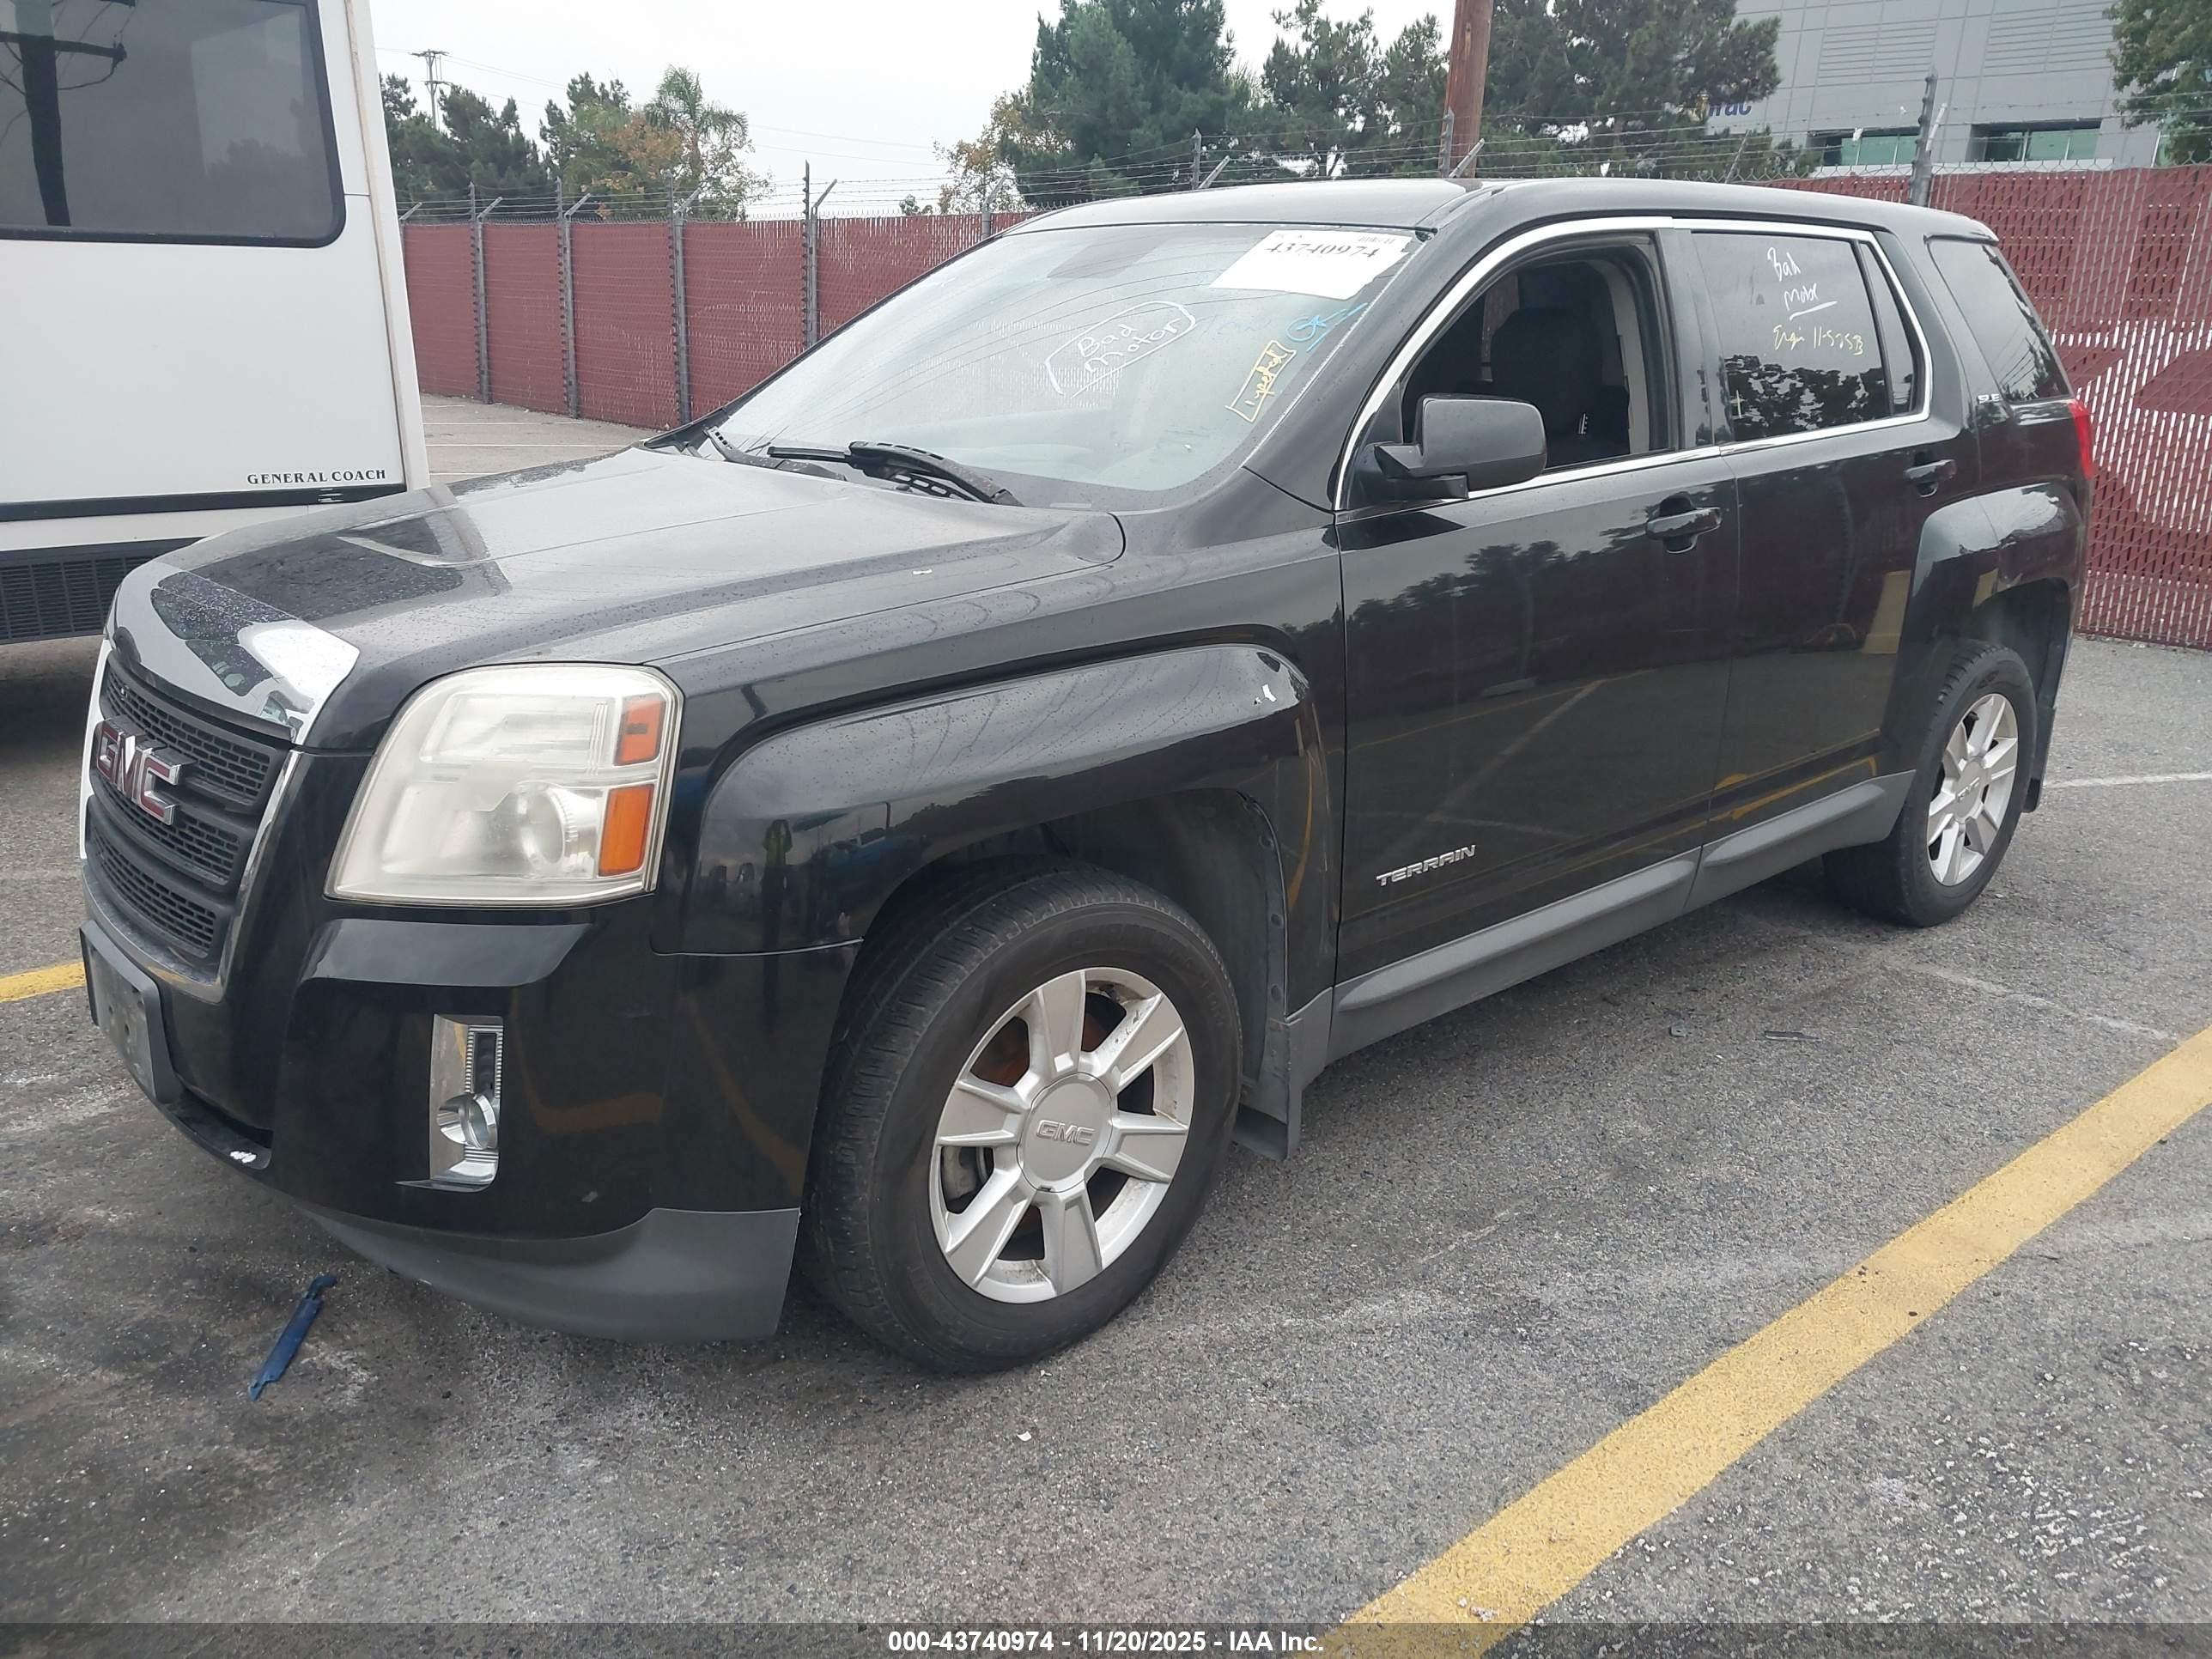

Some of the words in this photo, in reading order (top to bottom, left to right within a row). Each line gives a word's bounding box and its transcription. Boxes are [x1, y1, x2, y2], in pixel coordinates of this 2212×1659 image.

[1264, 241, 1381, 258] 43740974
[1077, 322, 1138, 358] Bad
[246, 472, 328, 484] GENERAL
[331, 470, 386, 482] COACH
[95, 717, 184, 826] GMC
[1376, 844, 1476, 887] TERRAIN
[1036, 1119, 1096, 1146] GMC
